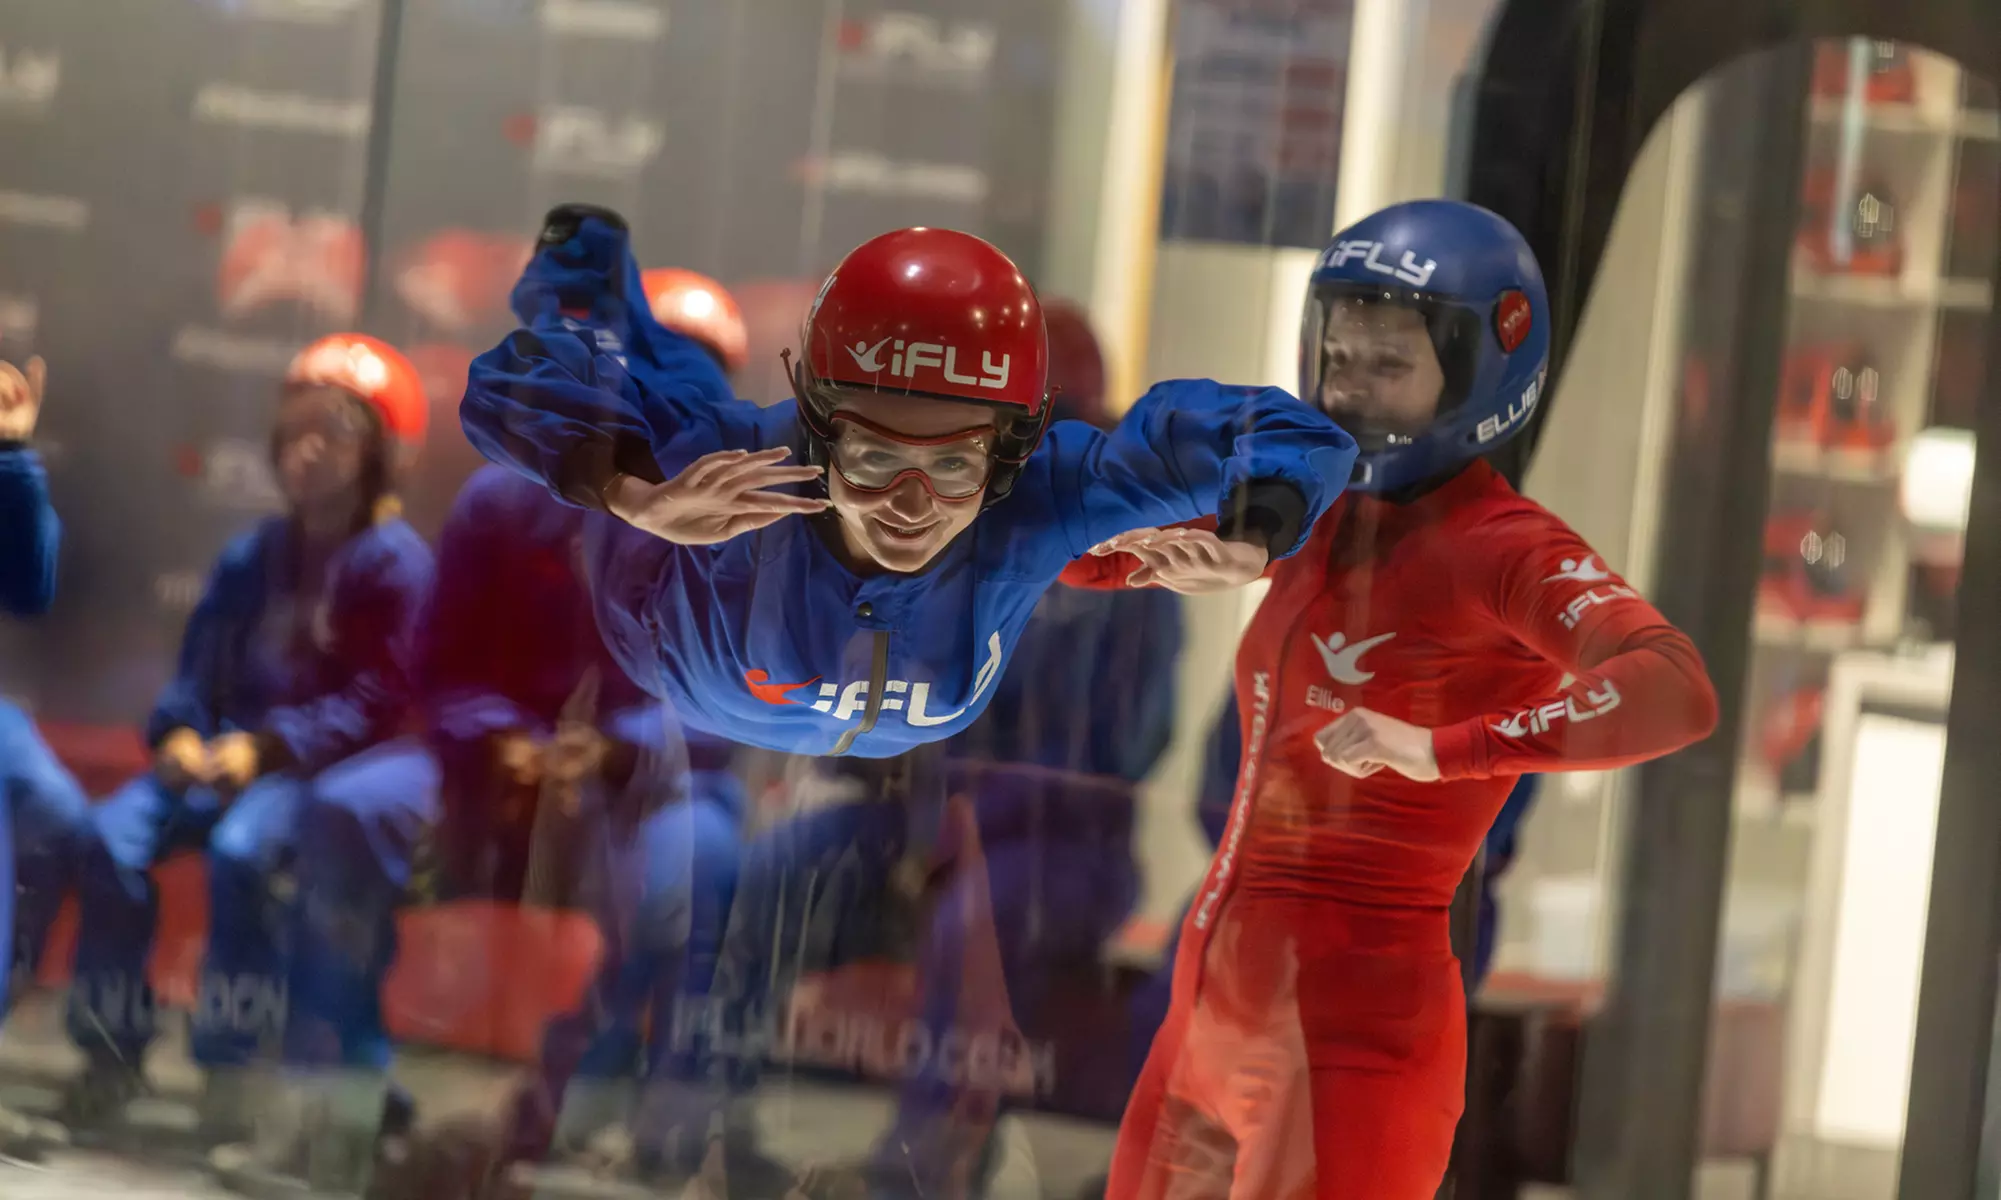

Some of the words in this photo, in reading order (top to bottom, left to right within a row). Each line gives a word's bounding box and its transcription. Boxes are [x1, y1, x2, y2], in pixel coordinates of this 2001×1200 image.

[1328, 239, 1437, 287] iFLY
[890, 338, 1011, 390] iFLY
[1304, 684, 1346, 713] Ellie
[1528, 678, 1622, 736] iFLY
